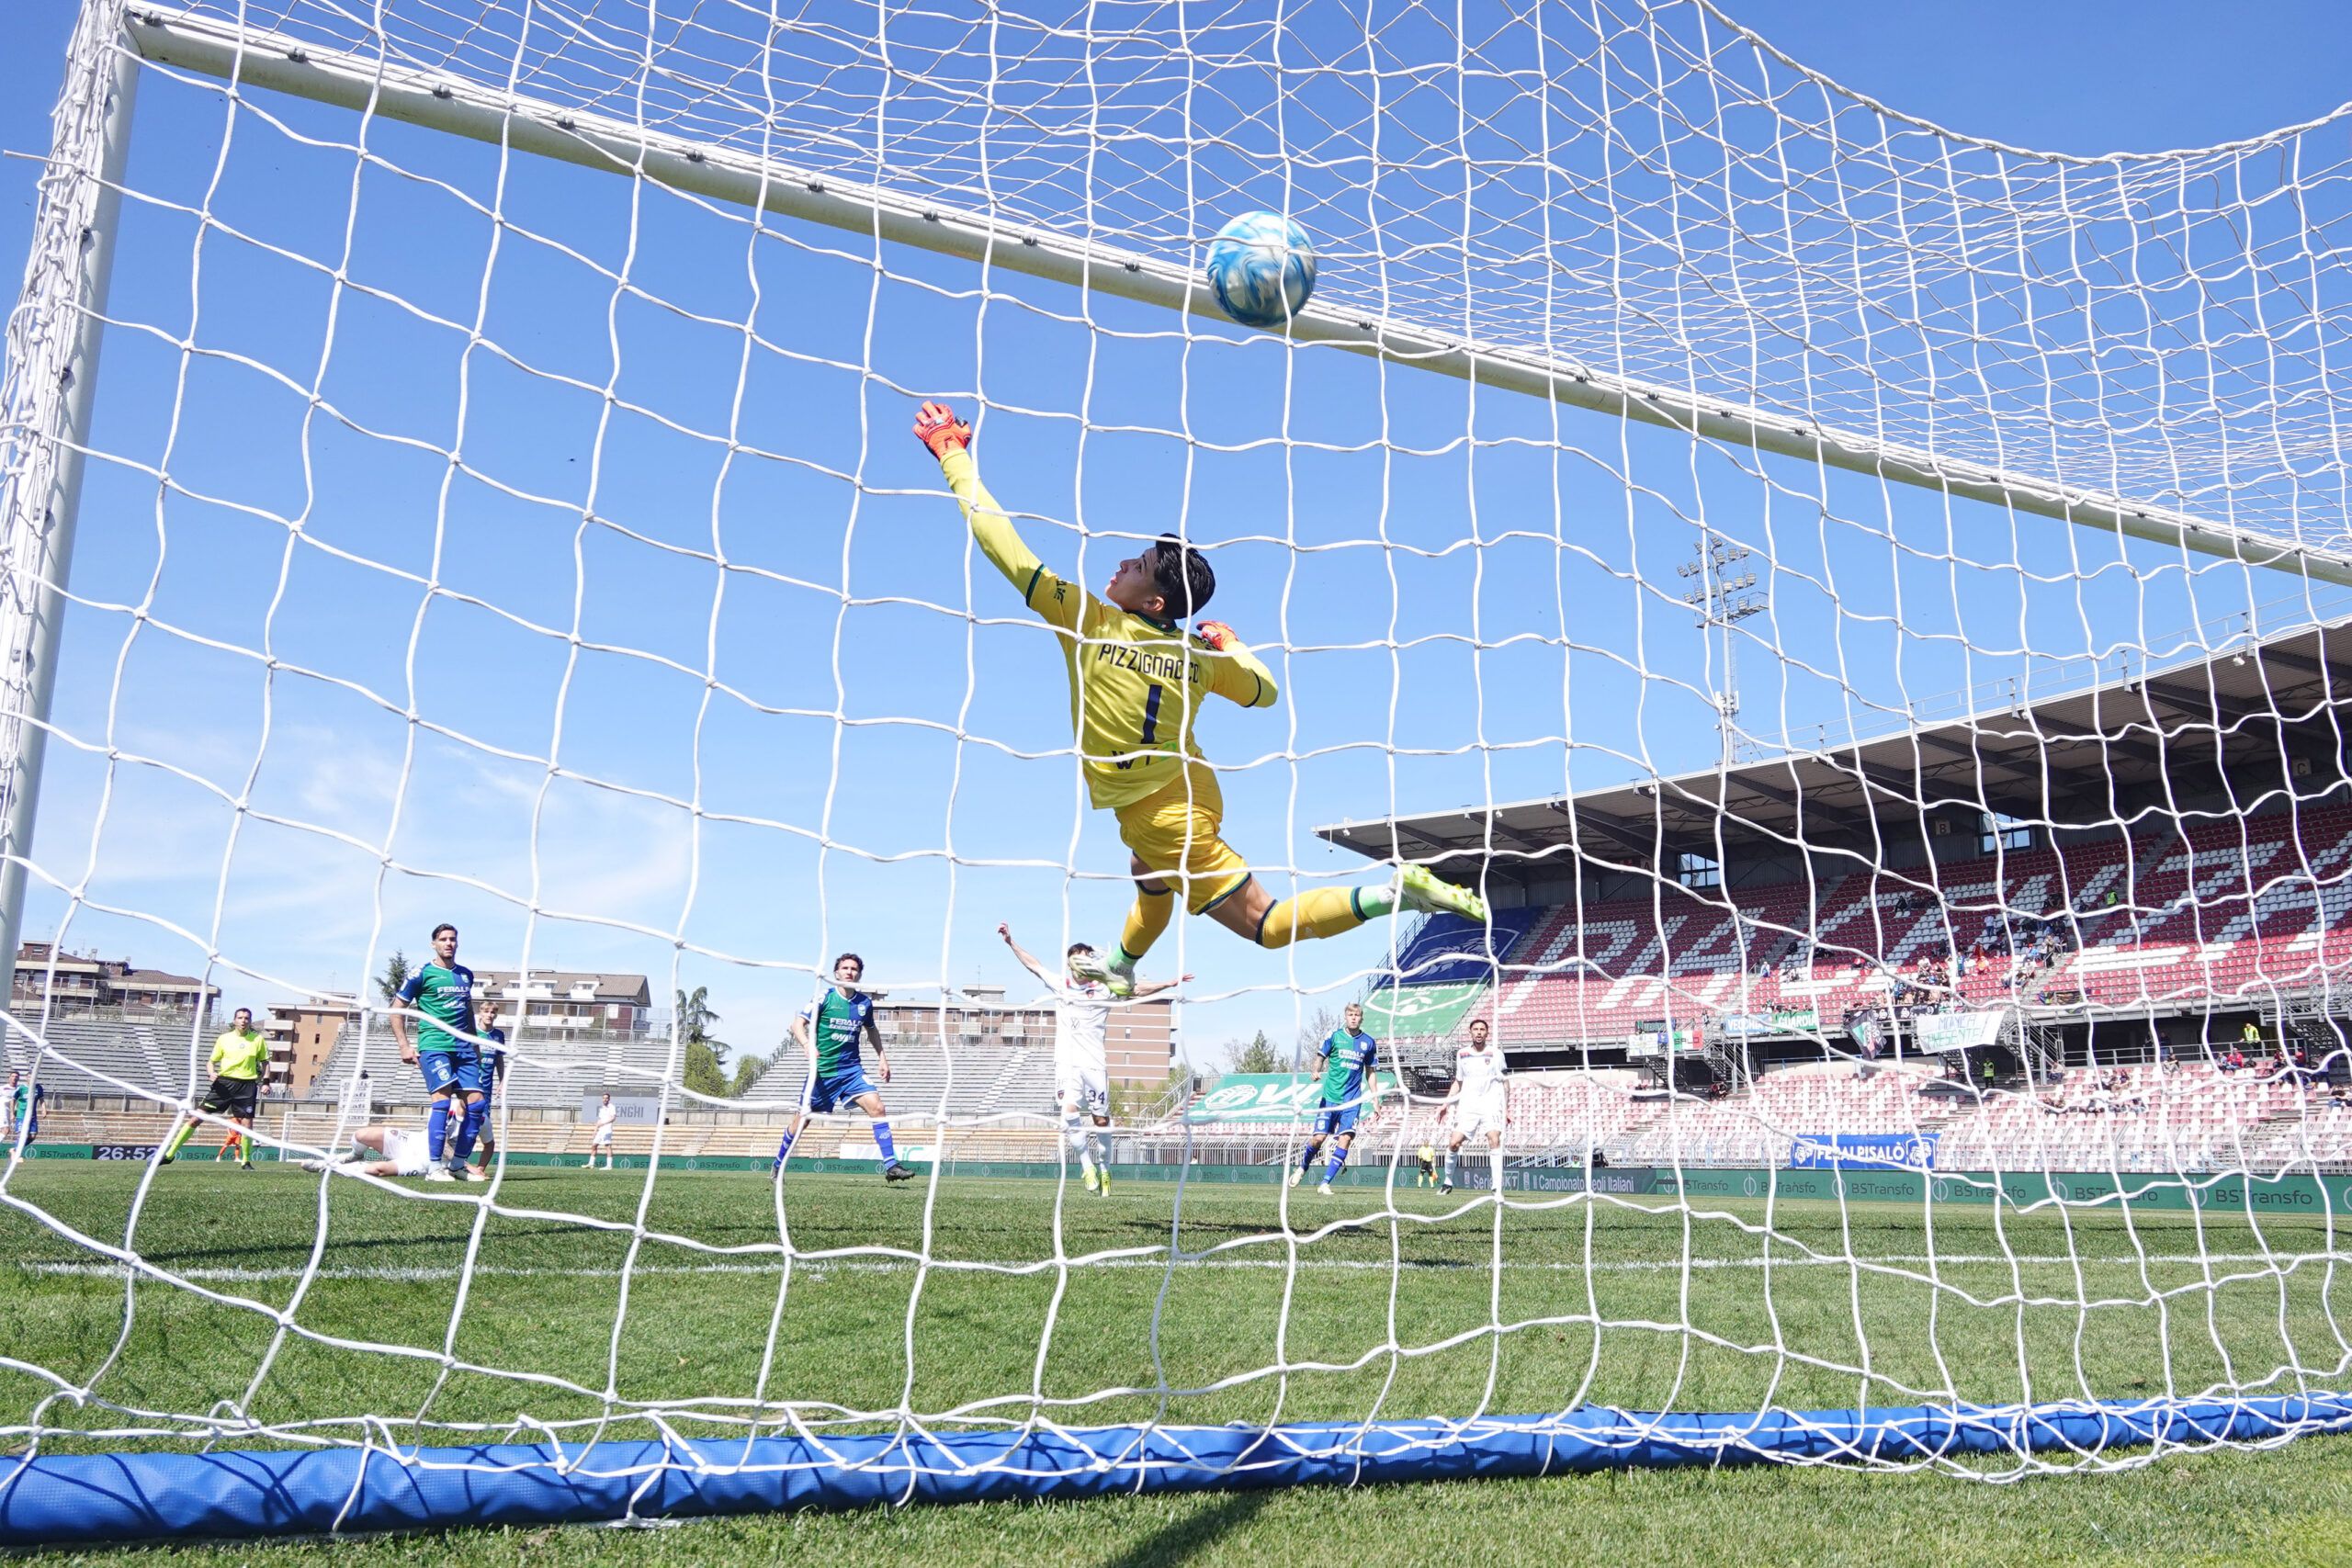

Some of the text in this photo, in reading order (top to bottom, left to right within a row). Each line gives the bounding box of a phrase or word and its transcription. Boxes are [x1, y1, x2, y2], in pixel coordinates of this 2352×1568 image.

[1140, 683, 1162, 744] 1
[1088, 1089, 1105, 1105] 34
[98, 1146, 158, 1161] 26:52
[1817, 1141, 1905, 1161] FEALPISALÒ
[1539, 1175, 1585, 1192] Campionato
[1587, 1176, 1607, 1193] egli
[1608, 1176, 1634, 1192] Italiani
[1682, 1179, 1729, 1192] STransfo
[1760, 1180, 1816, 1194] BTransfo
[1851, 1182, 1915, 1196] BSTransfo
[1954, 1185, 2027, 1199] BSTrasfo
